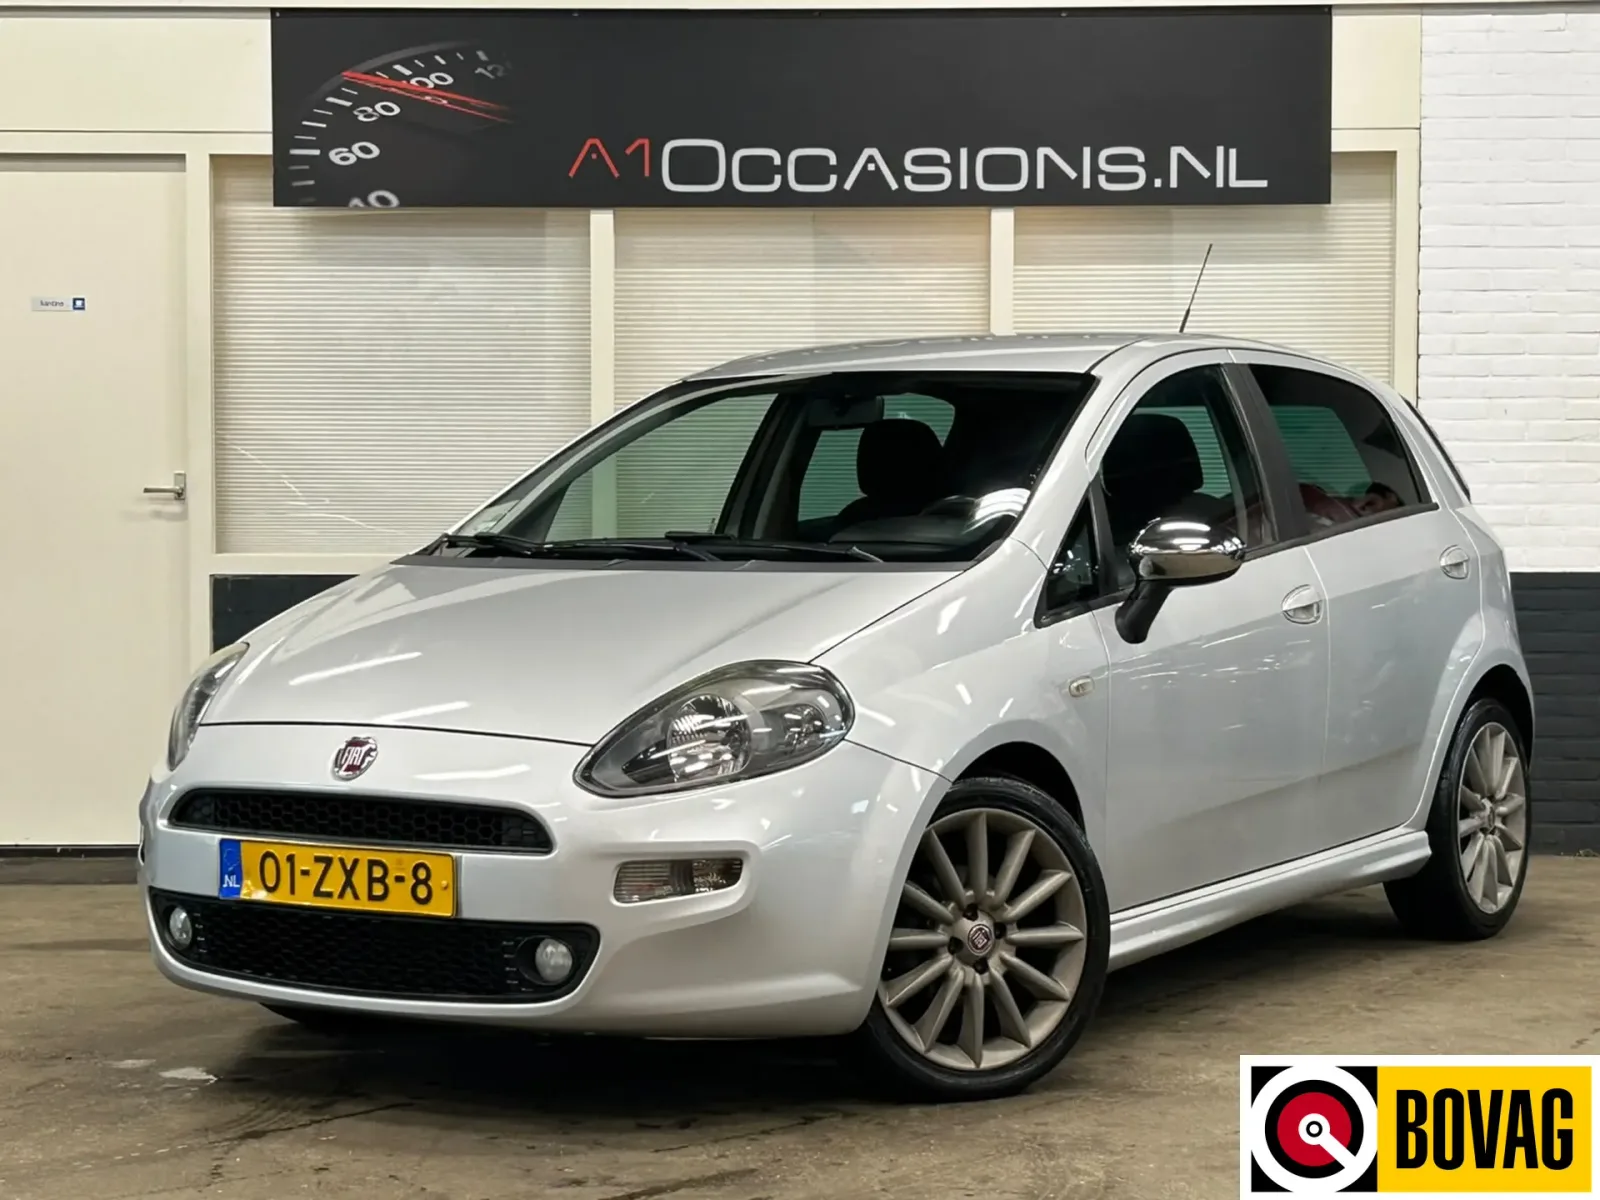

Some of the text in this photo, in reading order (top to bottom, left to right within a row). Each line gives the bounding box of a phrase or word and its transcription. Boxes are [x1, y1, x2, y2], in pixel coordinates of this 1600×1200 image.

[353, 101, 401, 122] 80
[328, 141, 381, 166] 60
[222, 873, 241, 888] NL
[259, 849, 434, 906] 01-ZXB-8
